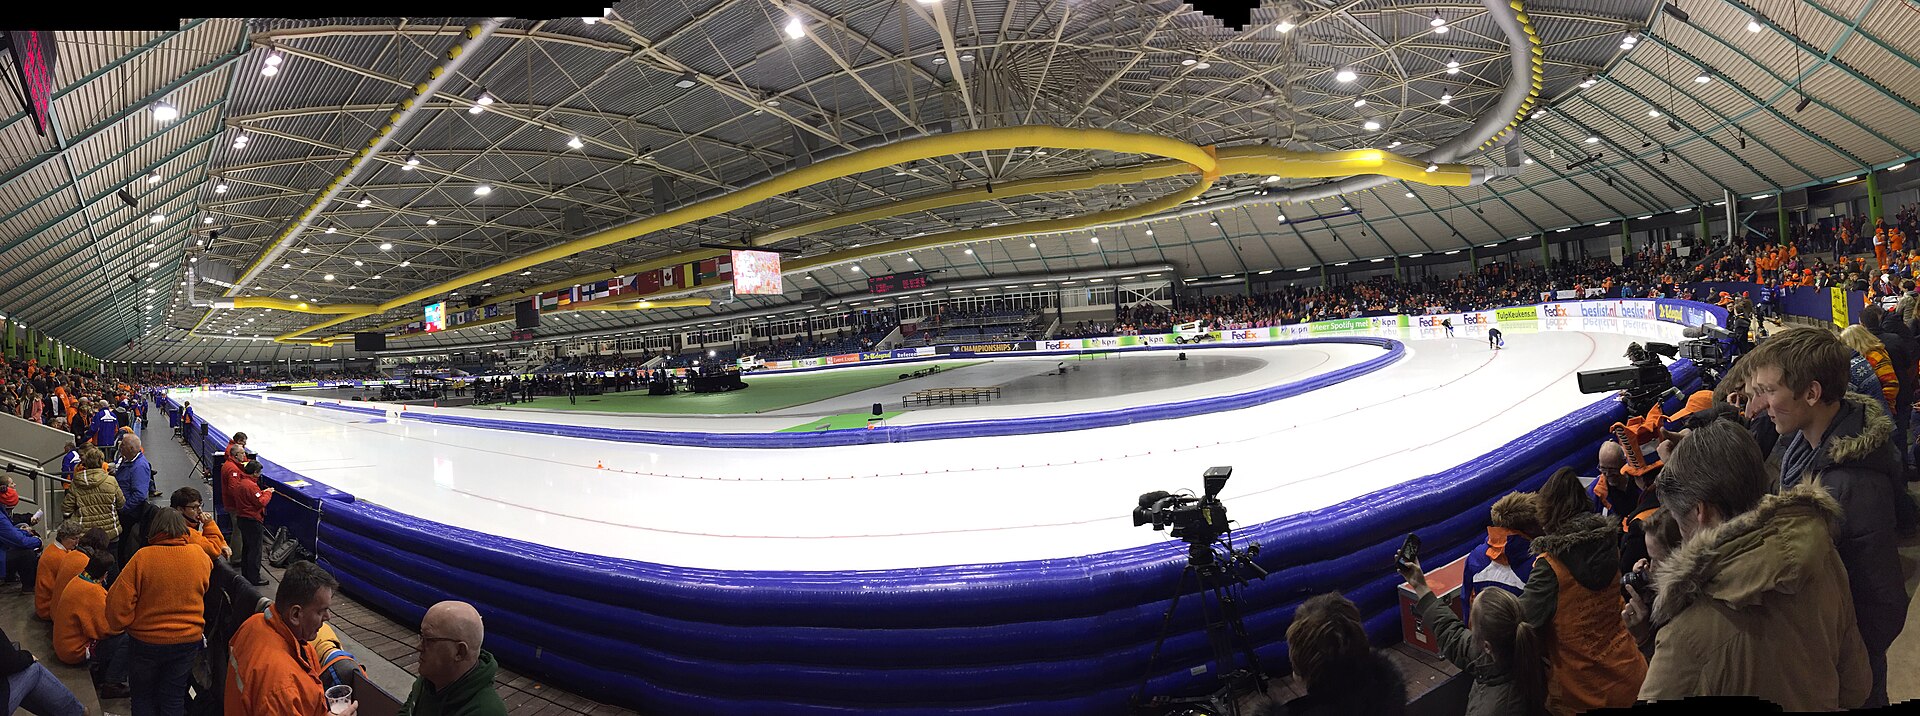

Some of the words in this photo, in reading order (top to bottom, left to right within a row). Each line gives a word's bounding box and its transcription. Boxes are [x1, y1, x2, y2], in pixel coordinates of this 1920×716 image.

[1497, 309, 1537, 320] TulpKeukens.nl
[1544, 304, 1568, 317] FedEx
[1581, 303, 1617, 317] beslist.nl
[1621, 303, 1655, 320] beslist.nl
[1381, 318, 1397, 327] kpn
[1419, 316, 1443, 327] FedEx
[1464, 313, 1488, 325] FedEx
[1312, 323, 1330, 331] Meer
[1331, 321, 1354, 330] Spotify
[1355, 319, 1369, 328] met
[1149, 335, 1164, 344] kpn
[1231, 330, 1257, 340] FedEx
[960, 343, 1011, 352] CHAMPIONSHIPS
[1045, 341, 1071, 350] FedEx
[1101, 338, 1117, 346] kpn
